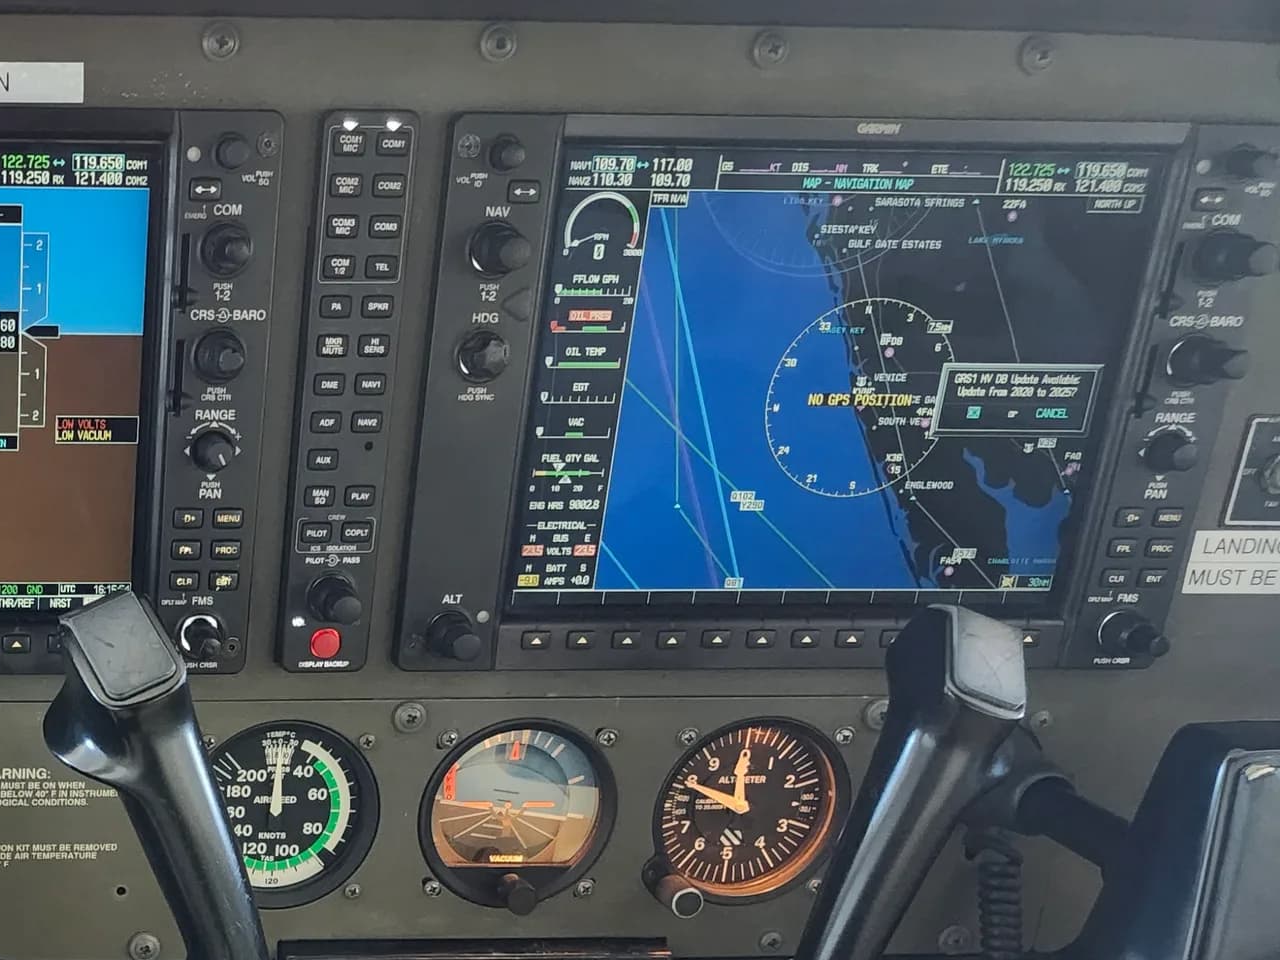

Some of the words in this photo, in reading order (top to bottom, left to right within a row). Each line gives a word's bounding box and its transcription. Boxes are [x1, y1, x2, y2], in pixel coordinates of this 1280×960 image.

[383, 140, 405, 149] COM1
[1, 155, 50, 169] 122.725
[74, 155, 123, 169] 119.650
[126, 159, 148, 170] COM1
[1, 171, 50, 185] 119.250
[74, 172, 123, 185] 121.400
[126, 175, 148, 186] COM2
[802, 177, 821, 188] MAP
[834, 178, 892, 189] NAVIGATION
[895, 179, 914, 190] MAP
[378, 181, 401, 190] COM2
[875, 198, 920, 207] SARASOTA
[213, 204, 242, 215] COM
[485, 206, 510, 217] NAV
[374, 223, 397, 232] COM3
[821, 224, 854, 234] SIESTA
[859, 224, 877, 234] KEY
[848, 239, 871, 248] GULF
[875, 240, 898, 249] GATE
[902, 240, 942, 249] ESTATES
[190, 310, 215, 321] CRS
[232, 310, 266, 322] BARO
[472, 313, 498, 324] HDG
[874, 373, 907, 382] VENICE
[808, 394, 824, 406] NO
[828, 394, 850, 406] GPS
[854, 394, 912, 407] POSITION
[195, 410, 236, 421] RANGE
[1035, 407, 1069, 418] CANCEL
[1155, 413, 1196, 423] RANGE
[57, 418, 75, 430] LOW
[77, 418, 106, 430] VOLTS
[57, 429, 75, 441] LOW
[77, 429, 111, 441] VACUUM
[905, 481, 954, 490] ENGLEWOOD
[199, 489, 222, 500] PAN
[1188, 569, 1247, 585] MUST
[1250, 570, 1278, 586] BE
[49, 598, 72, 608] NRST
[708, 757, 720, 771] 9
[236, 769, 267, 782] 200
[293, 765, 314, 778] 40
[0, 782, 26, 790] MUST
[28, 782, 40, 790] BE
[42, 782, 56, 790] ON
[57, 782, 85, 790] WHEN
[784, 775, 796, 788] 2
[226, 785, 251, 798] 180
[307, 788, 328, 801] 60
[302, 822, 323, 835] 80
[680, 821, 690, 834] 7
[776, 819, 789, 832] 3
[258, 832, 286, 840] KNOTS
[754, 835, 766, 849] 4
[243, 842, 267, 855] 120
[694, 837, 705, 850] 6
[275, 844, 299, 857] 100
[721, 846, 733, 860] 5
